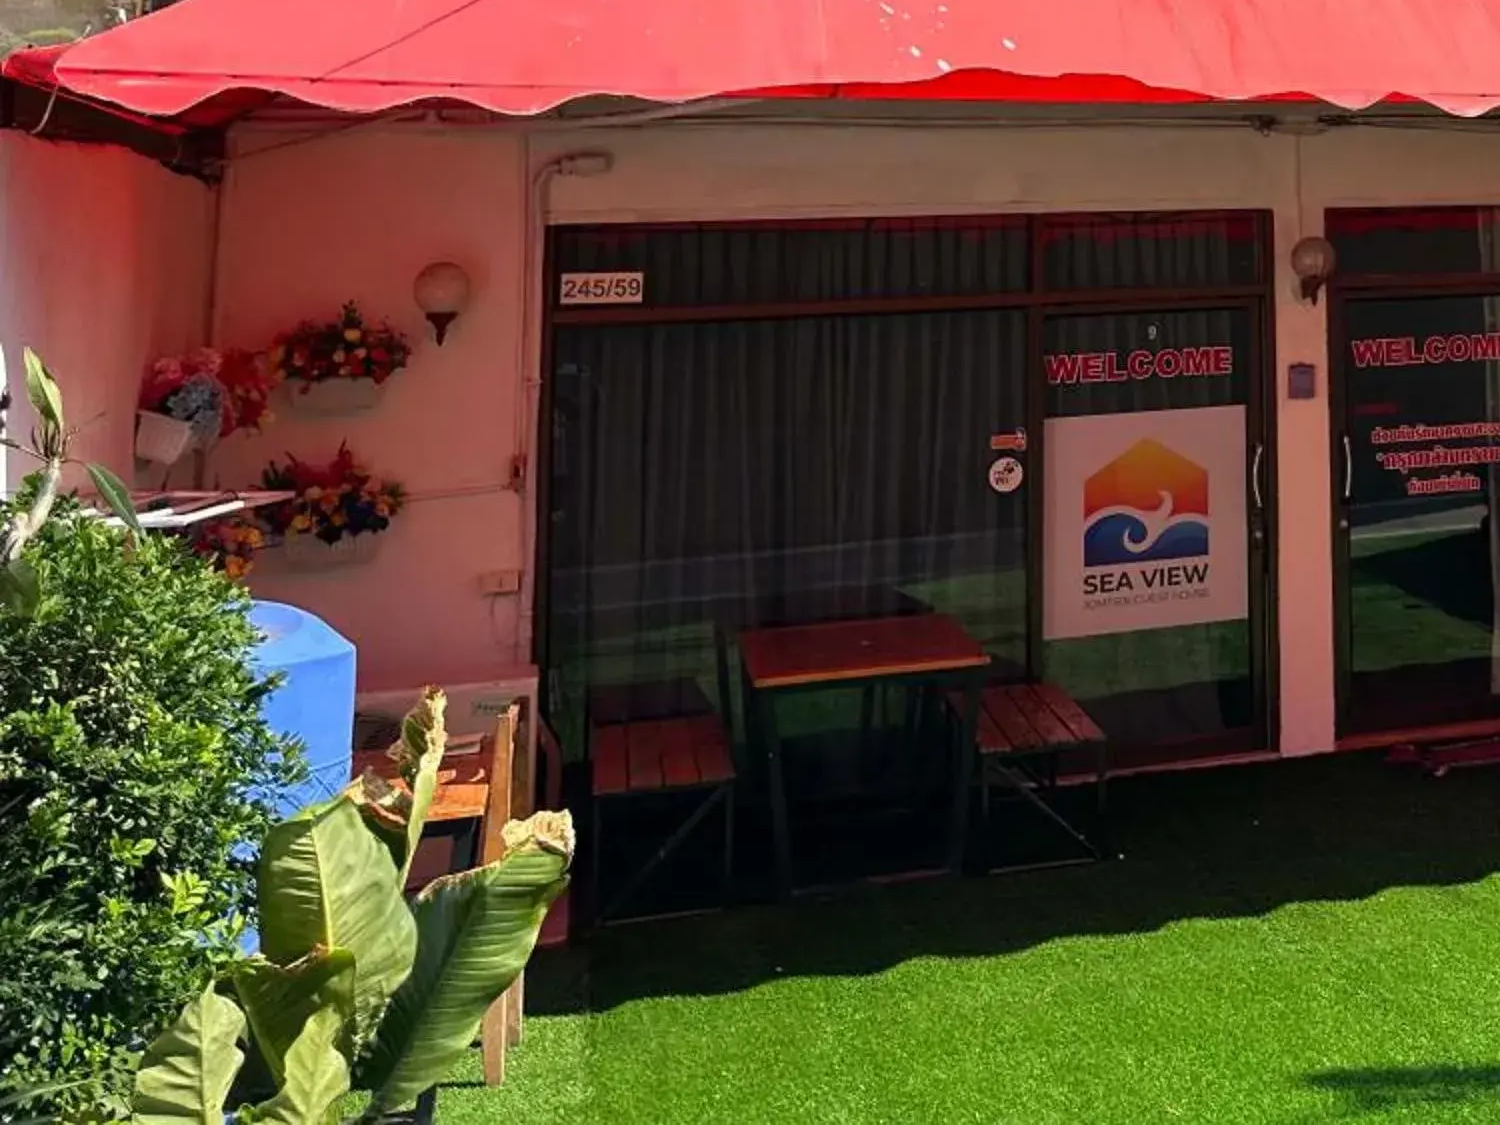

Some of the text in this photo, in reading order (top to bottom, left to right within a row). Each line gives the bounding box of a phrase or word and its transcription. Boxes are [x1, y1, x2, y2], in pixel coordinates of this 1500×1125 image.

[563, 278, 641, 299] 245/59
[1044, 346, 1232, 384] WELCOME
[1083, 563, 1209, 594] SEA VIEW
